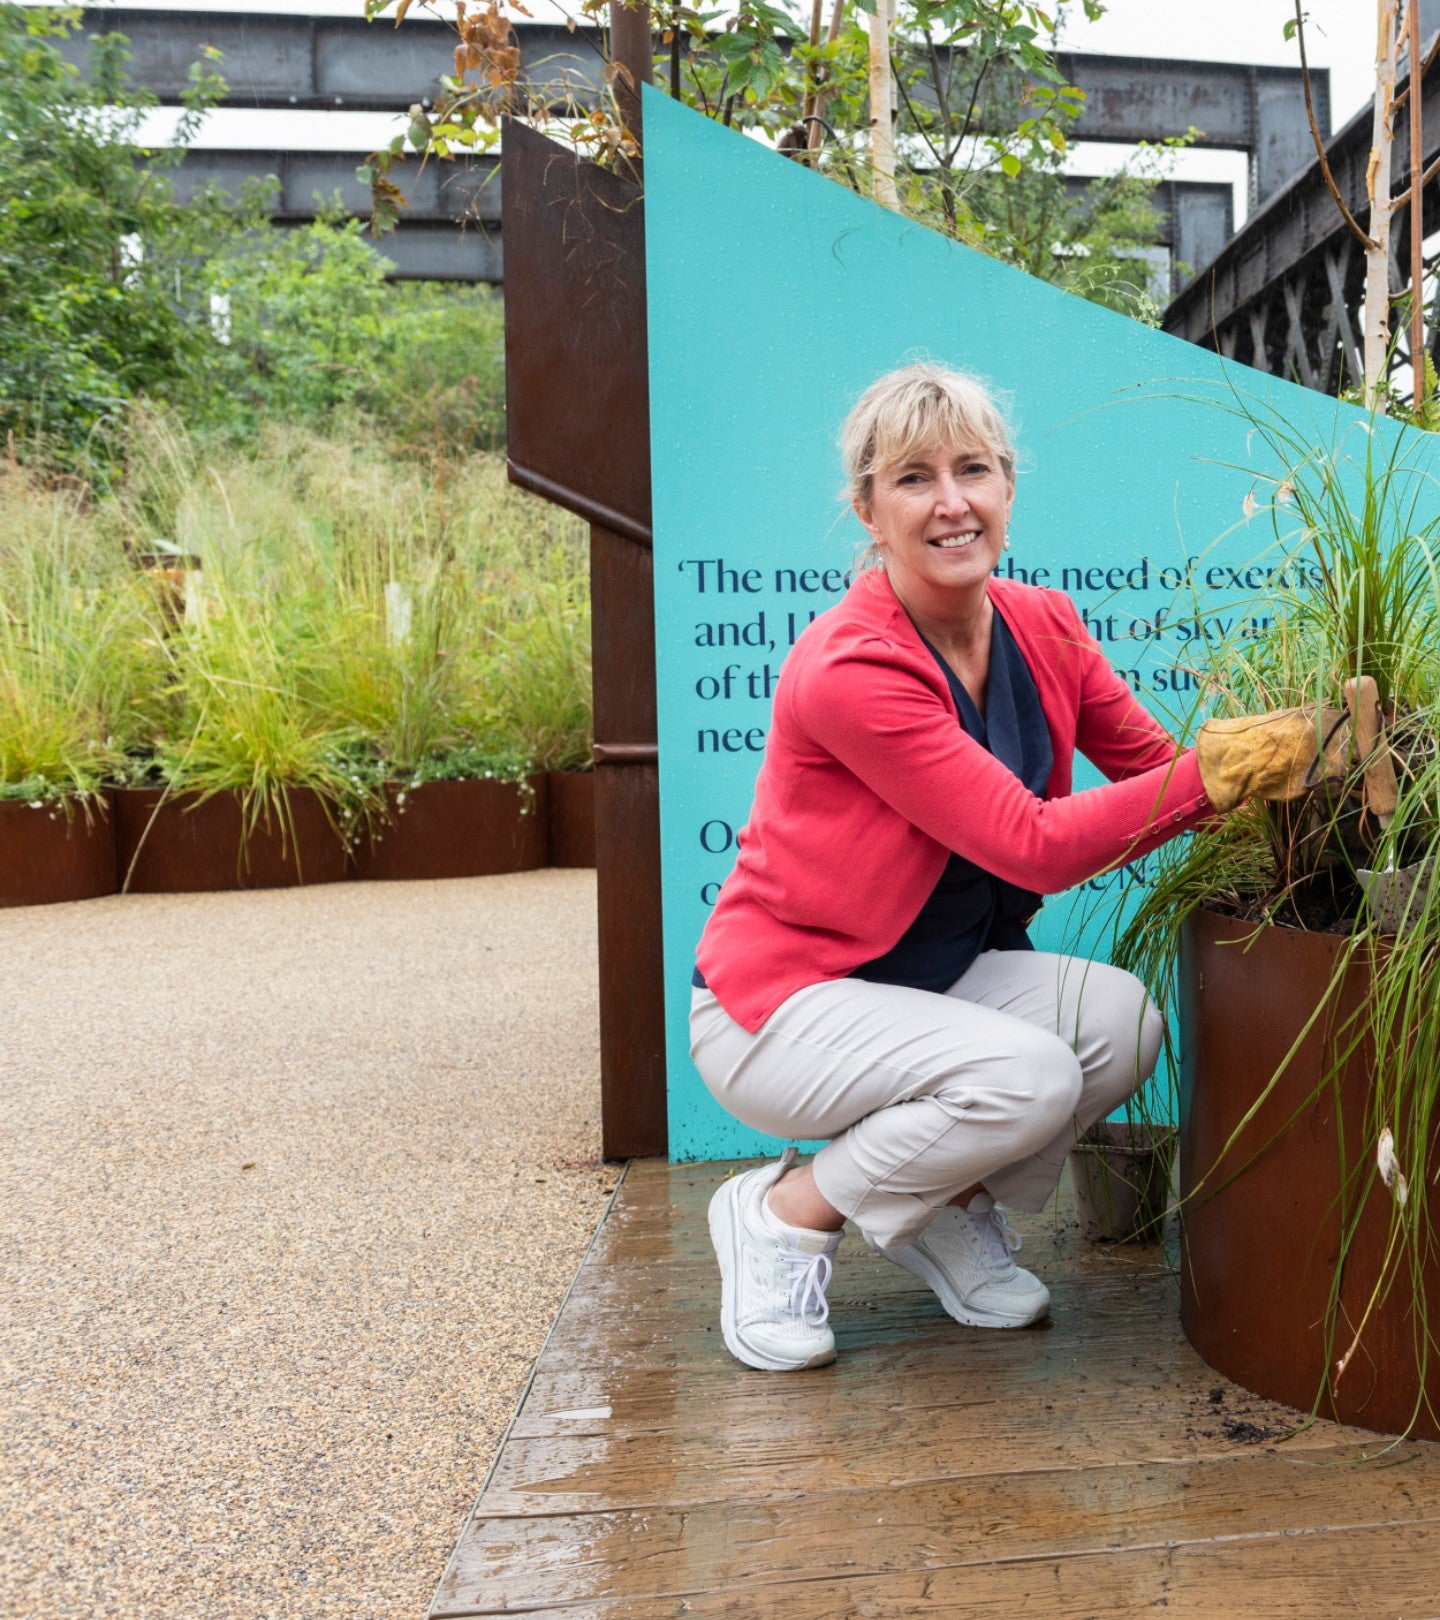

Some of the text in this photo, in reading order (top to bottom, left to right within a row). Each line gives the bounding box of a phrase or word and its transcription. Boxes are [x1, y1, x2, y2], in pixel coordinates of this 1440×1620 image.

[678, 558, 763, 593] ‘The
[992, 557, 1051, 589] the
[1062, 556, 1149, 591] need
[1159, 556, 1203, 590] of
[1206, 556, 1335, 590] exercis
[695, 611, 775, 653] and,
[1129, 607, 1171, 641] of
[1176, 607, 1233, 650] sky
[695, 664, 742, 700] of
[697, 728, 765, 753] nee
